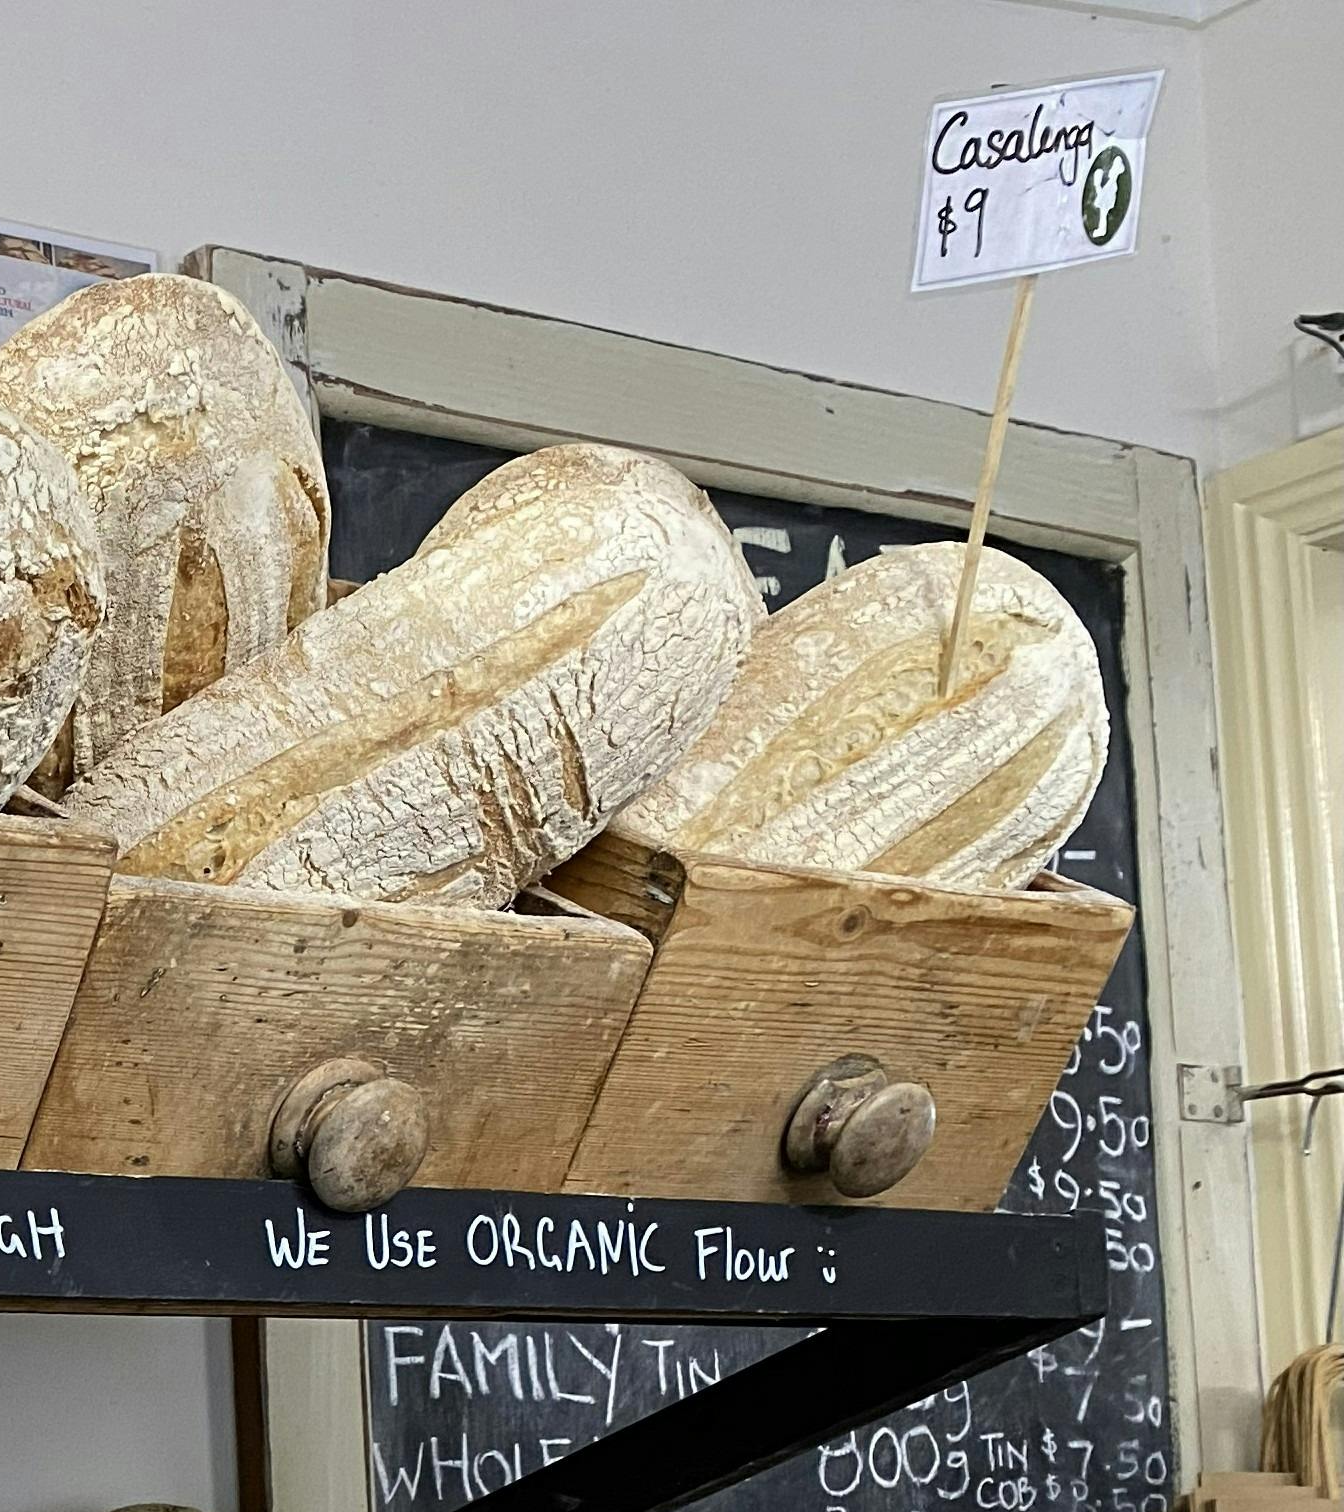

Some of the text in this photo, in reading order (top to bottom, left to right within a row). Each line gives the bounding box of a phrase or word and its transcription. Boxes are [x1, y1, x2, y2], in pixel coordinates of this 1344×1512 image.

[937, 187, 990, 258] $9
[264, 1207, 331, 1270] WE
[365, 1212, 438, 1270] USE
[694, 1226, 796, 1283] Flour
[383, 1323, 622, 1427] FAMILY
[640, 1339, 722, 1400] TIN
[979, 1432, 1028, 1473] TIN
[975, 1476, 1037, 1512] COB
